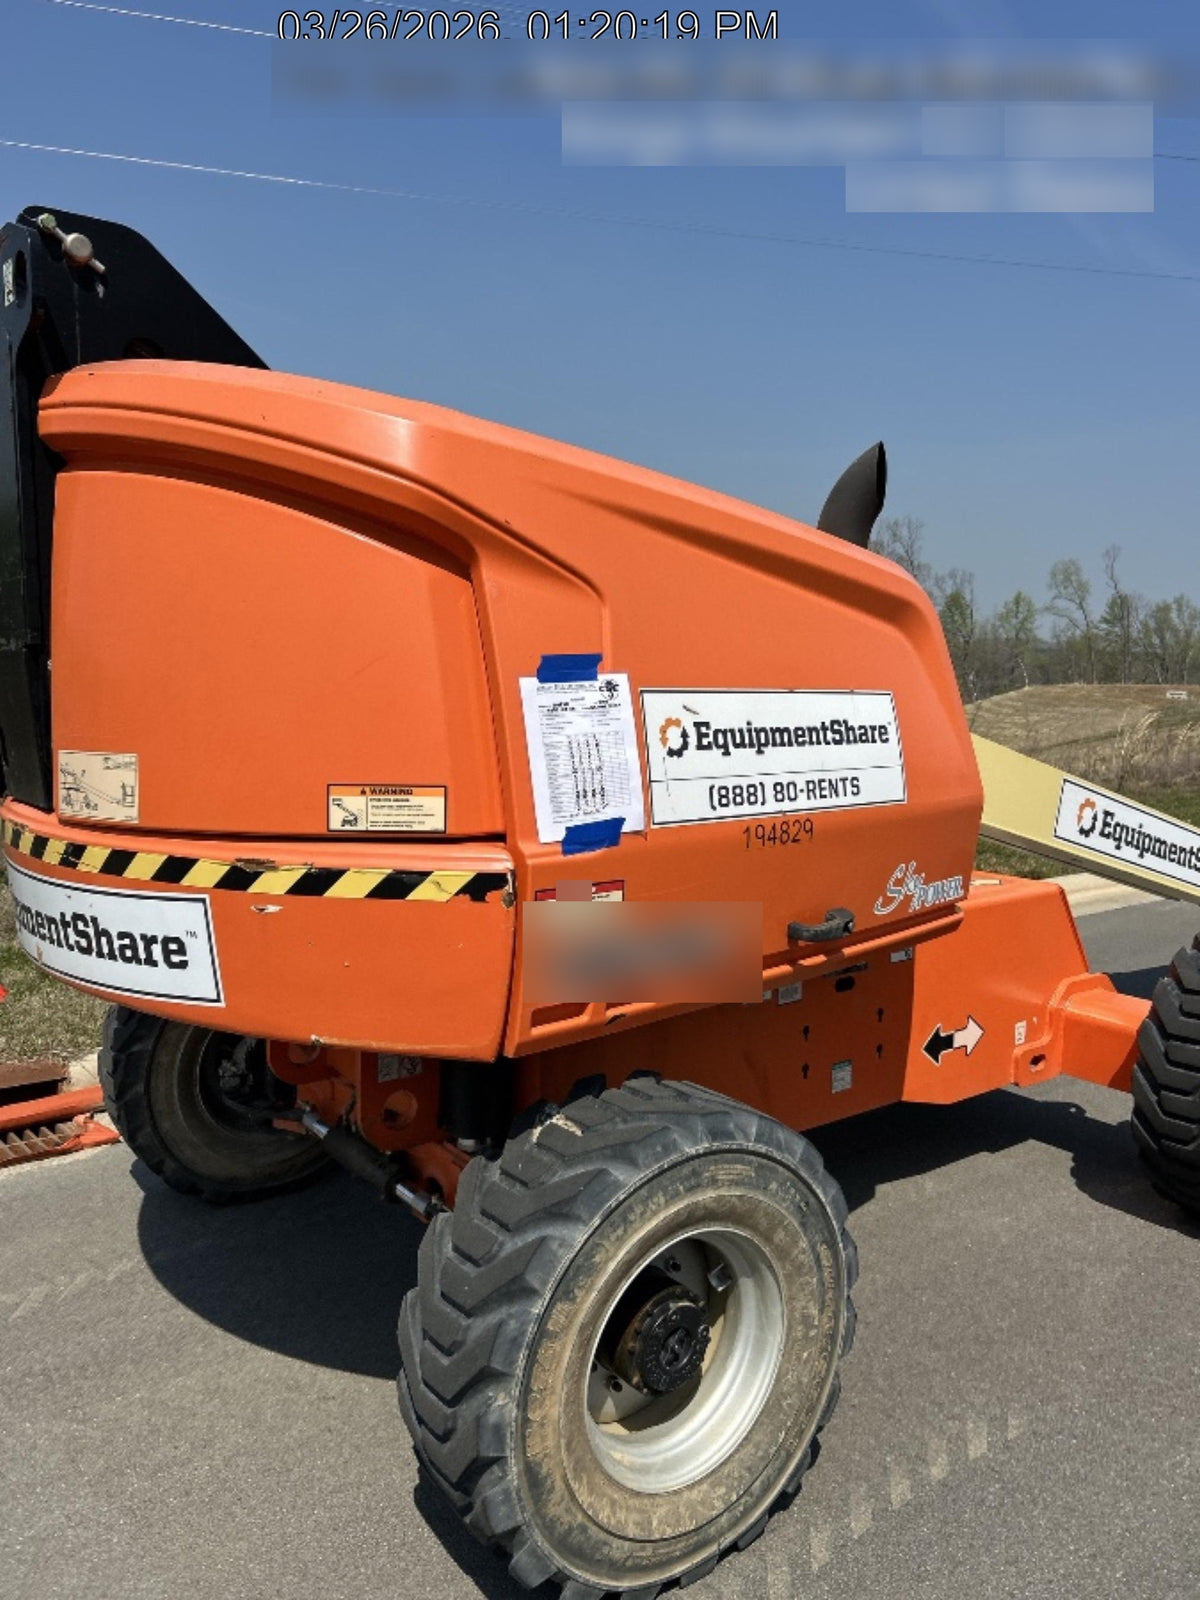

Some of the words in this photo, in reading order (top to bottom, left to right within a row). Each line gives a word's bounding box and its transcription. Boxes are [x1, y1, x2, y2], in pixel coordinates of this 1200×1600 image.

[693, 719, 890, 756] EquipmentShare
[709, 781, 766, 811] (888)
[773, 776, 861, 803] 80-RENTS
[743, 818, 814, 849] 194829
